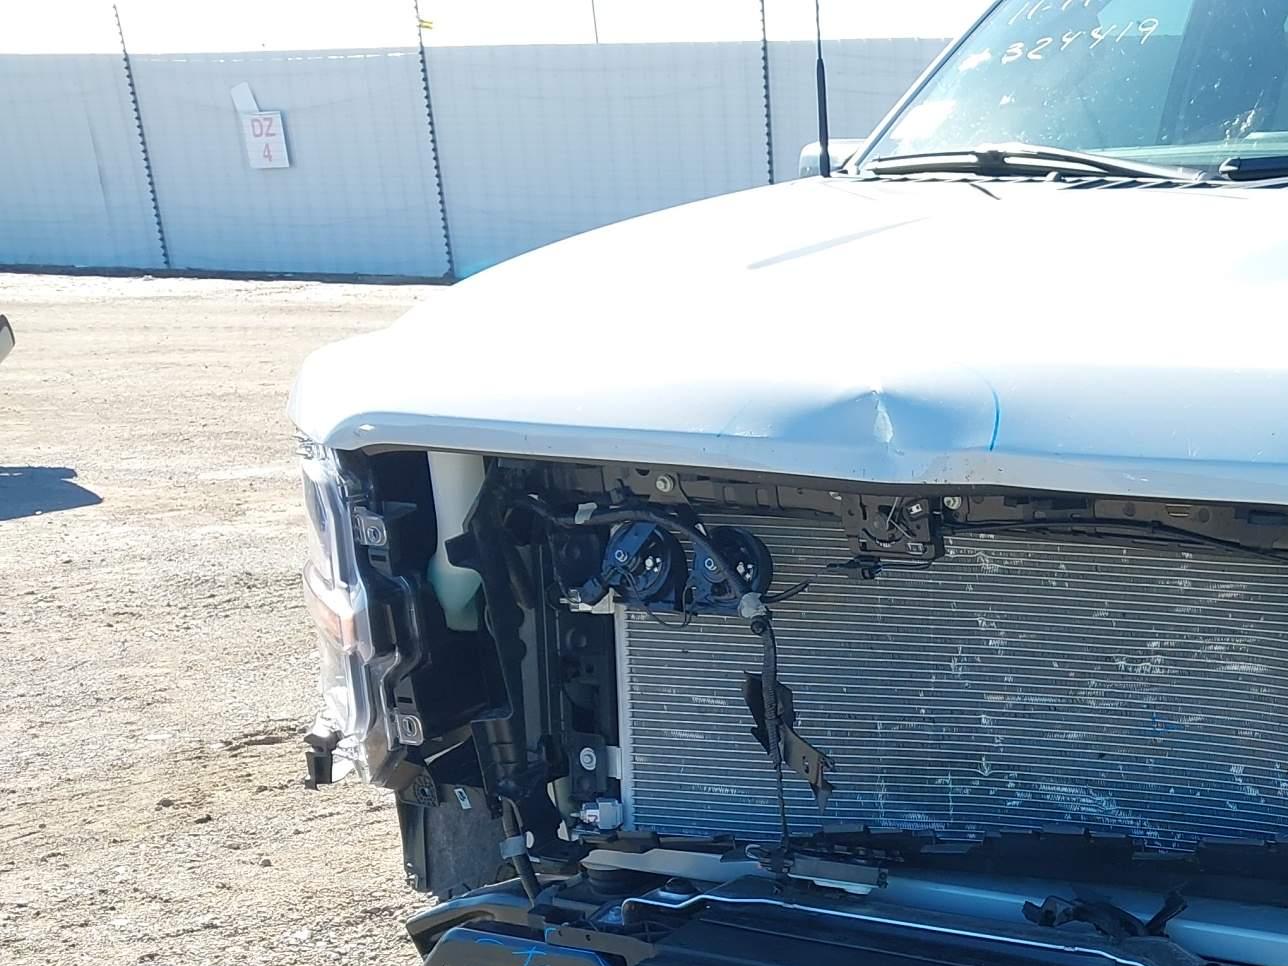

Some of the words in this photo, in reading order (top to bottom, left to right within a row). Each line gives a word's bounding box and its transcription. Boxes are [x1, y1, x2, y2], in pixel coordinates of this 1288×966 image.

[1001, 18, 1159, 65] 324419
[251, 117, 276, 138] DZ
[263, 143, 273, 162] 4
